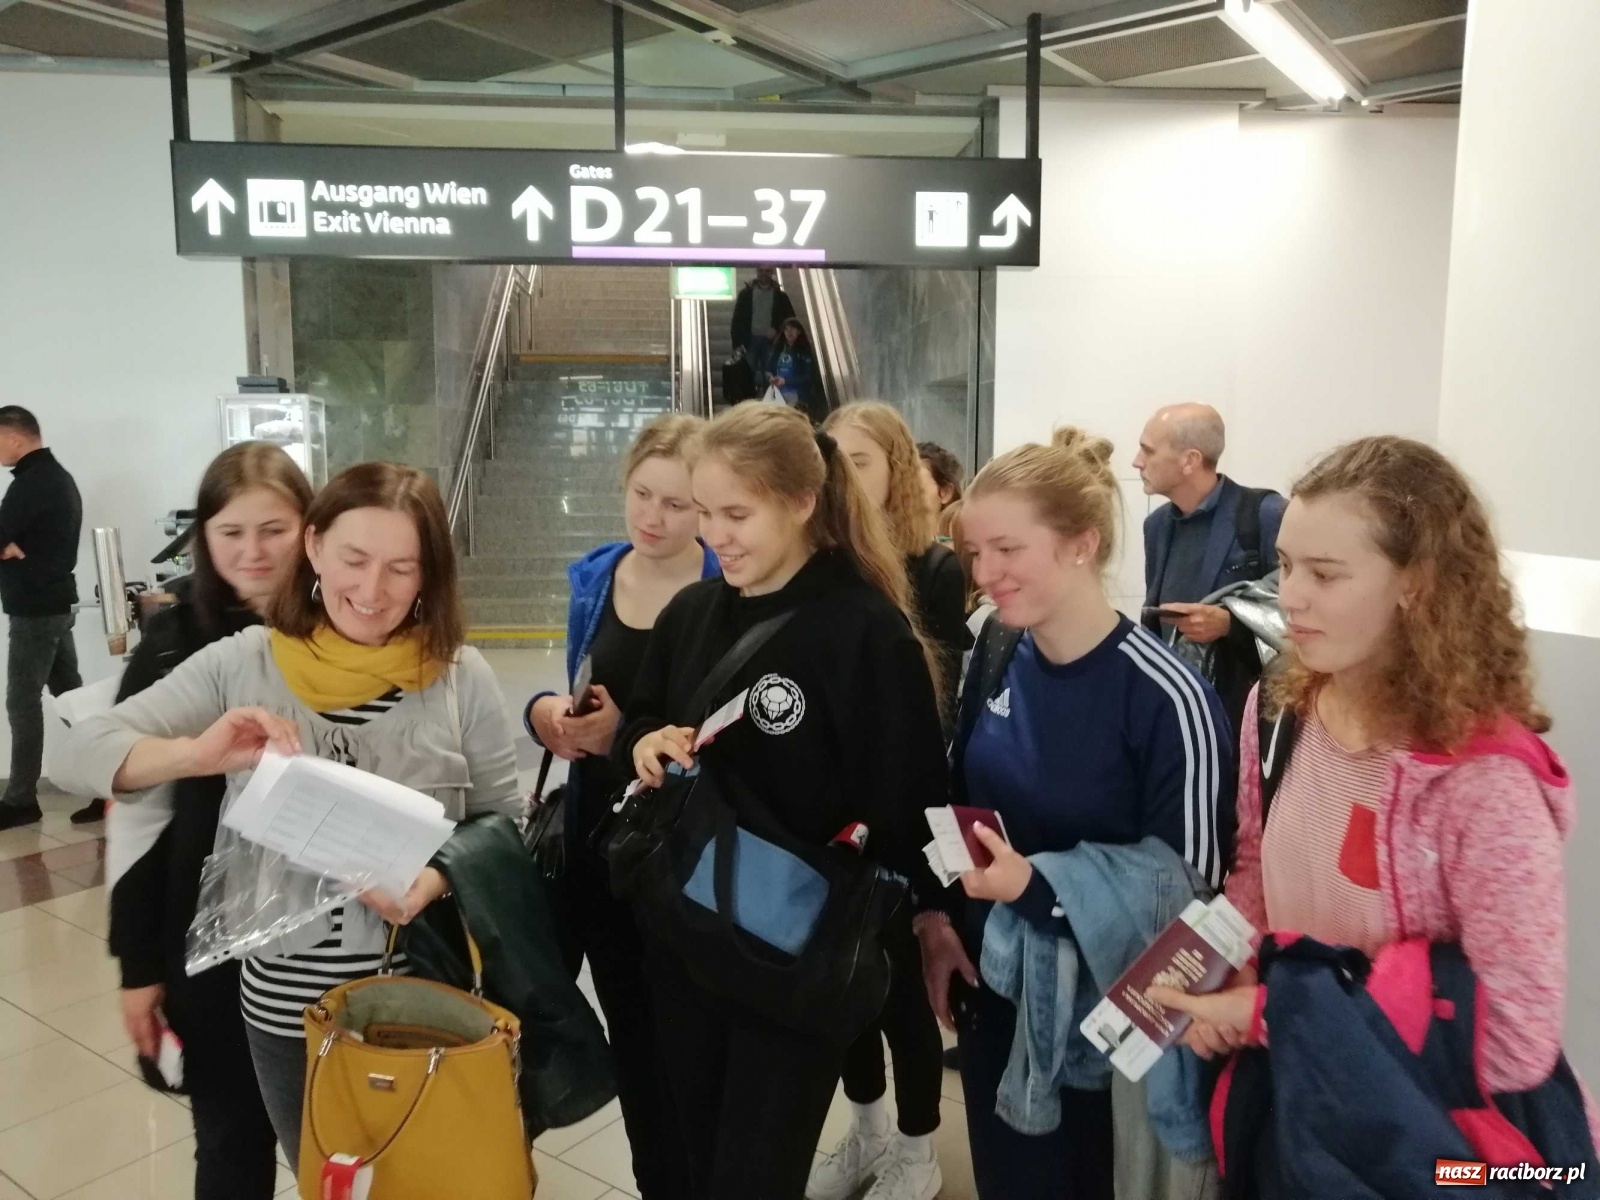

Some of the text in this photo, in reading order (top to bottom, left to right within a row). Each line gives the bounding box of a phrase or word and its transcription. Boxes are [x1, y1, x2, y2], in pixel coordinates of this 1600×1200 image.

[569, 163, 613, 179] Gates
[311, 180, 487, 208] Ausgang Wien
[313, 211, 451, 236] Exit Vienna
[570, 185, 624, 243] D
